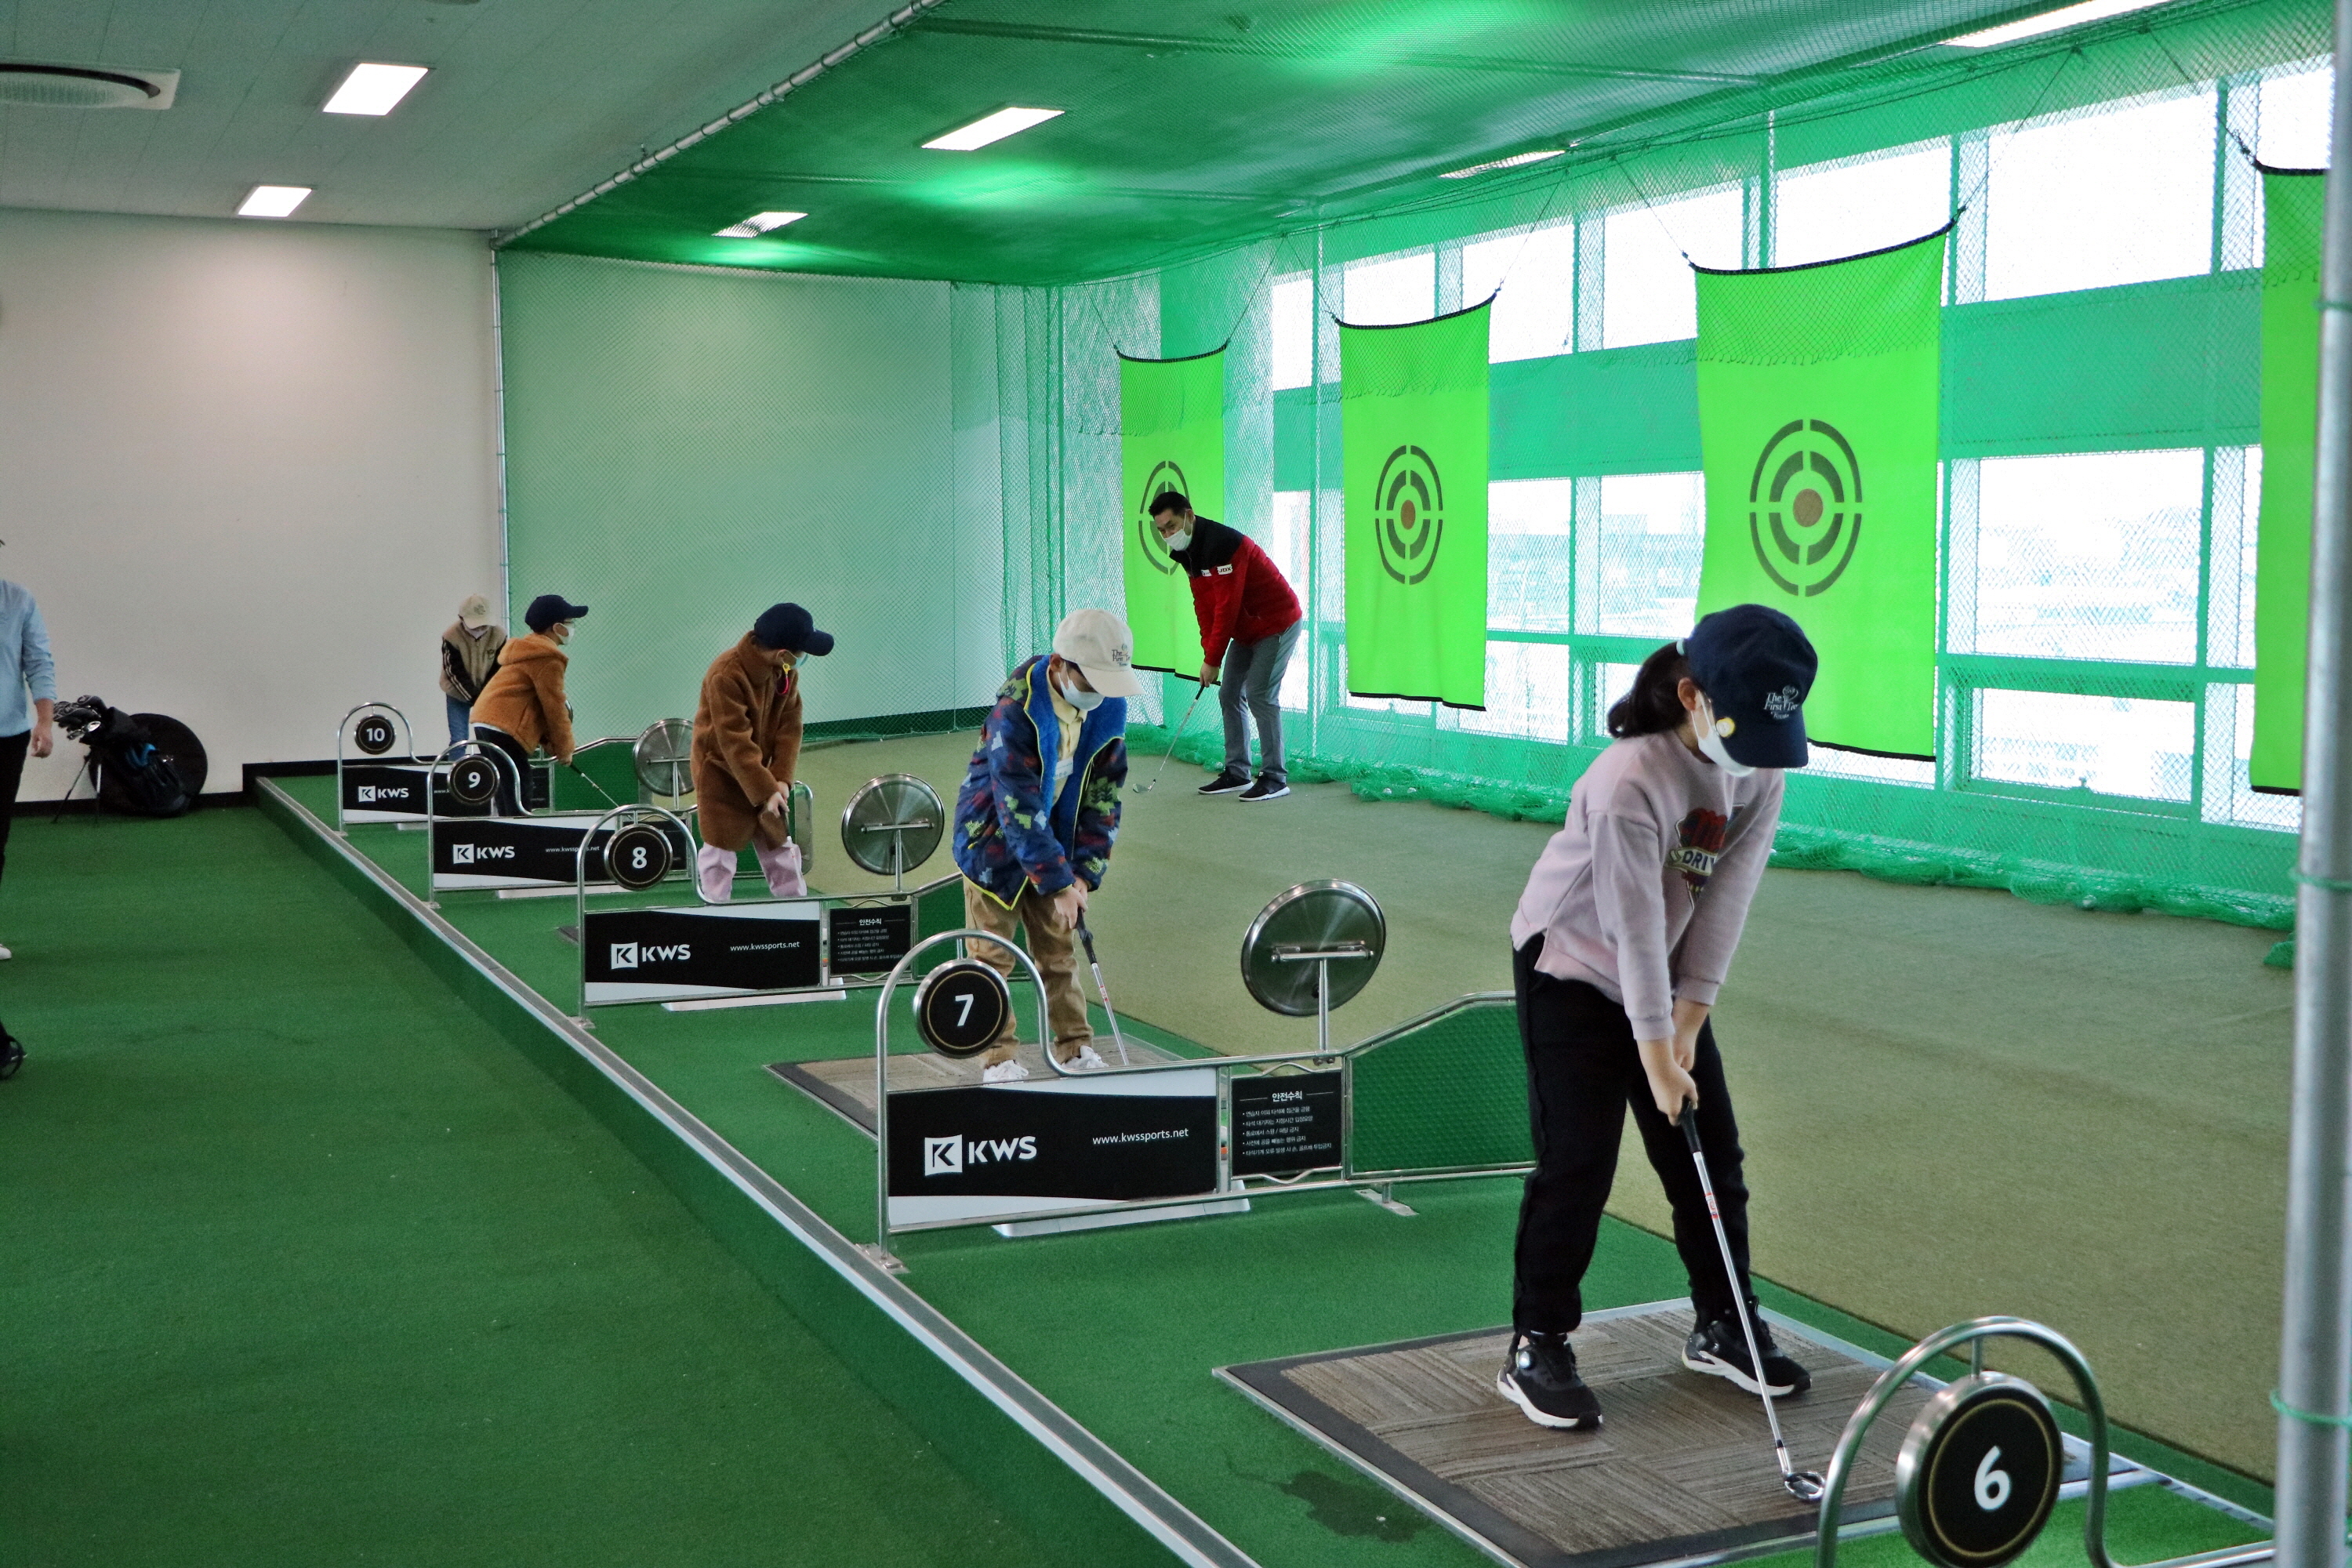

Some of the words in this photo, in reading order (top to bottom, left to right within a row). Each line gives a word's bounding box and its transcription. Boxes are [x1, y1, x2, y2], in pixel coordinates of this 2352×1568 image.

[1766, 692, 1782, 702] The
[1763, 701, 1783, 710] First
[366, 728, 386, 742] 10
[468, 771, 481, 788] 9
[377, 787, 409, 799] KWS
[477, 845, 515, 859] KWS
[632, 846, 648, 869] 8
[641, 943, 691, 963] KWS
[730, 941, 800, 952] www.kwssports.net
[955, 993, 975, 1027] 7
[1272, 1091, 1302, 1102] 안전수칙
[1092, 1127, 1189, 1145] www.kwssports.net
[968, 1135, 1037, 1164] KWS
[1973, 1446, 2011, 1511] 6
